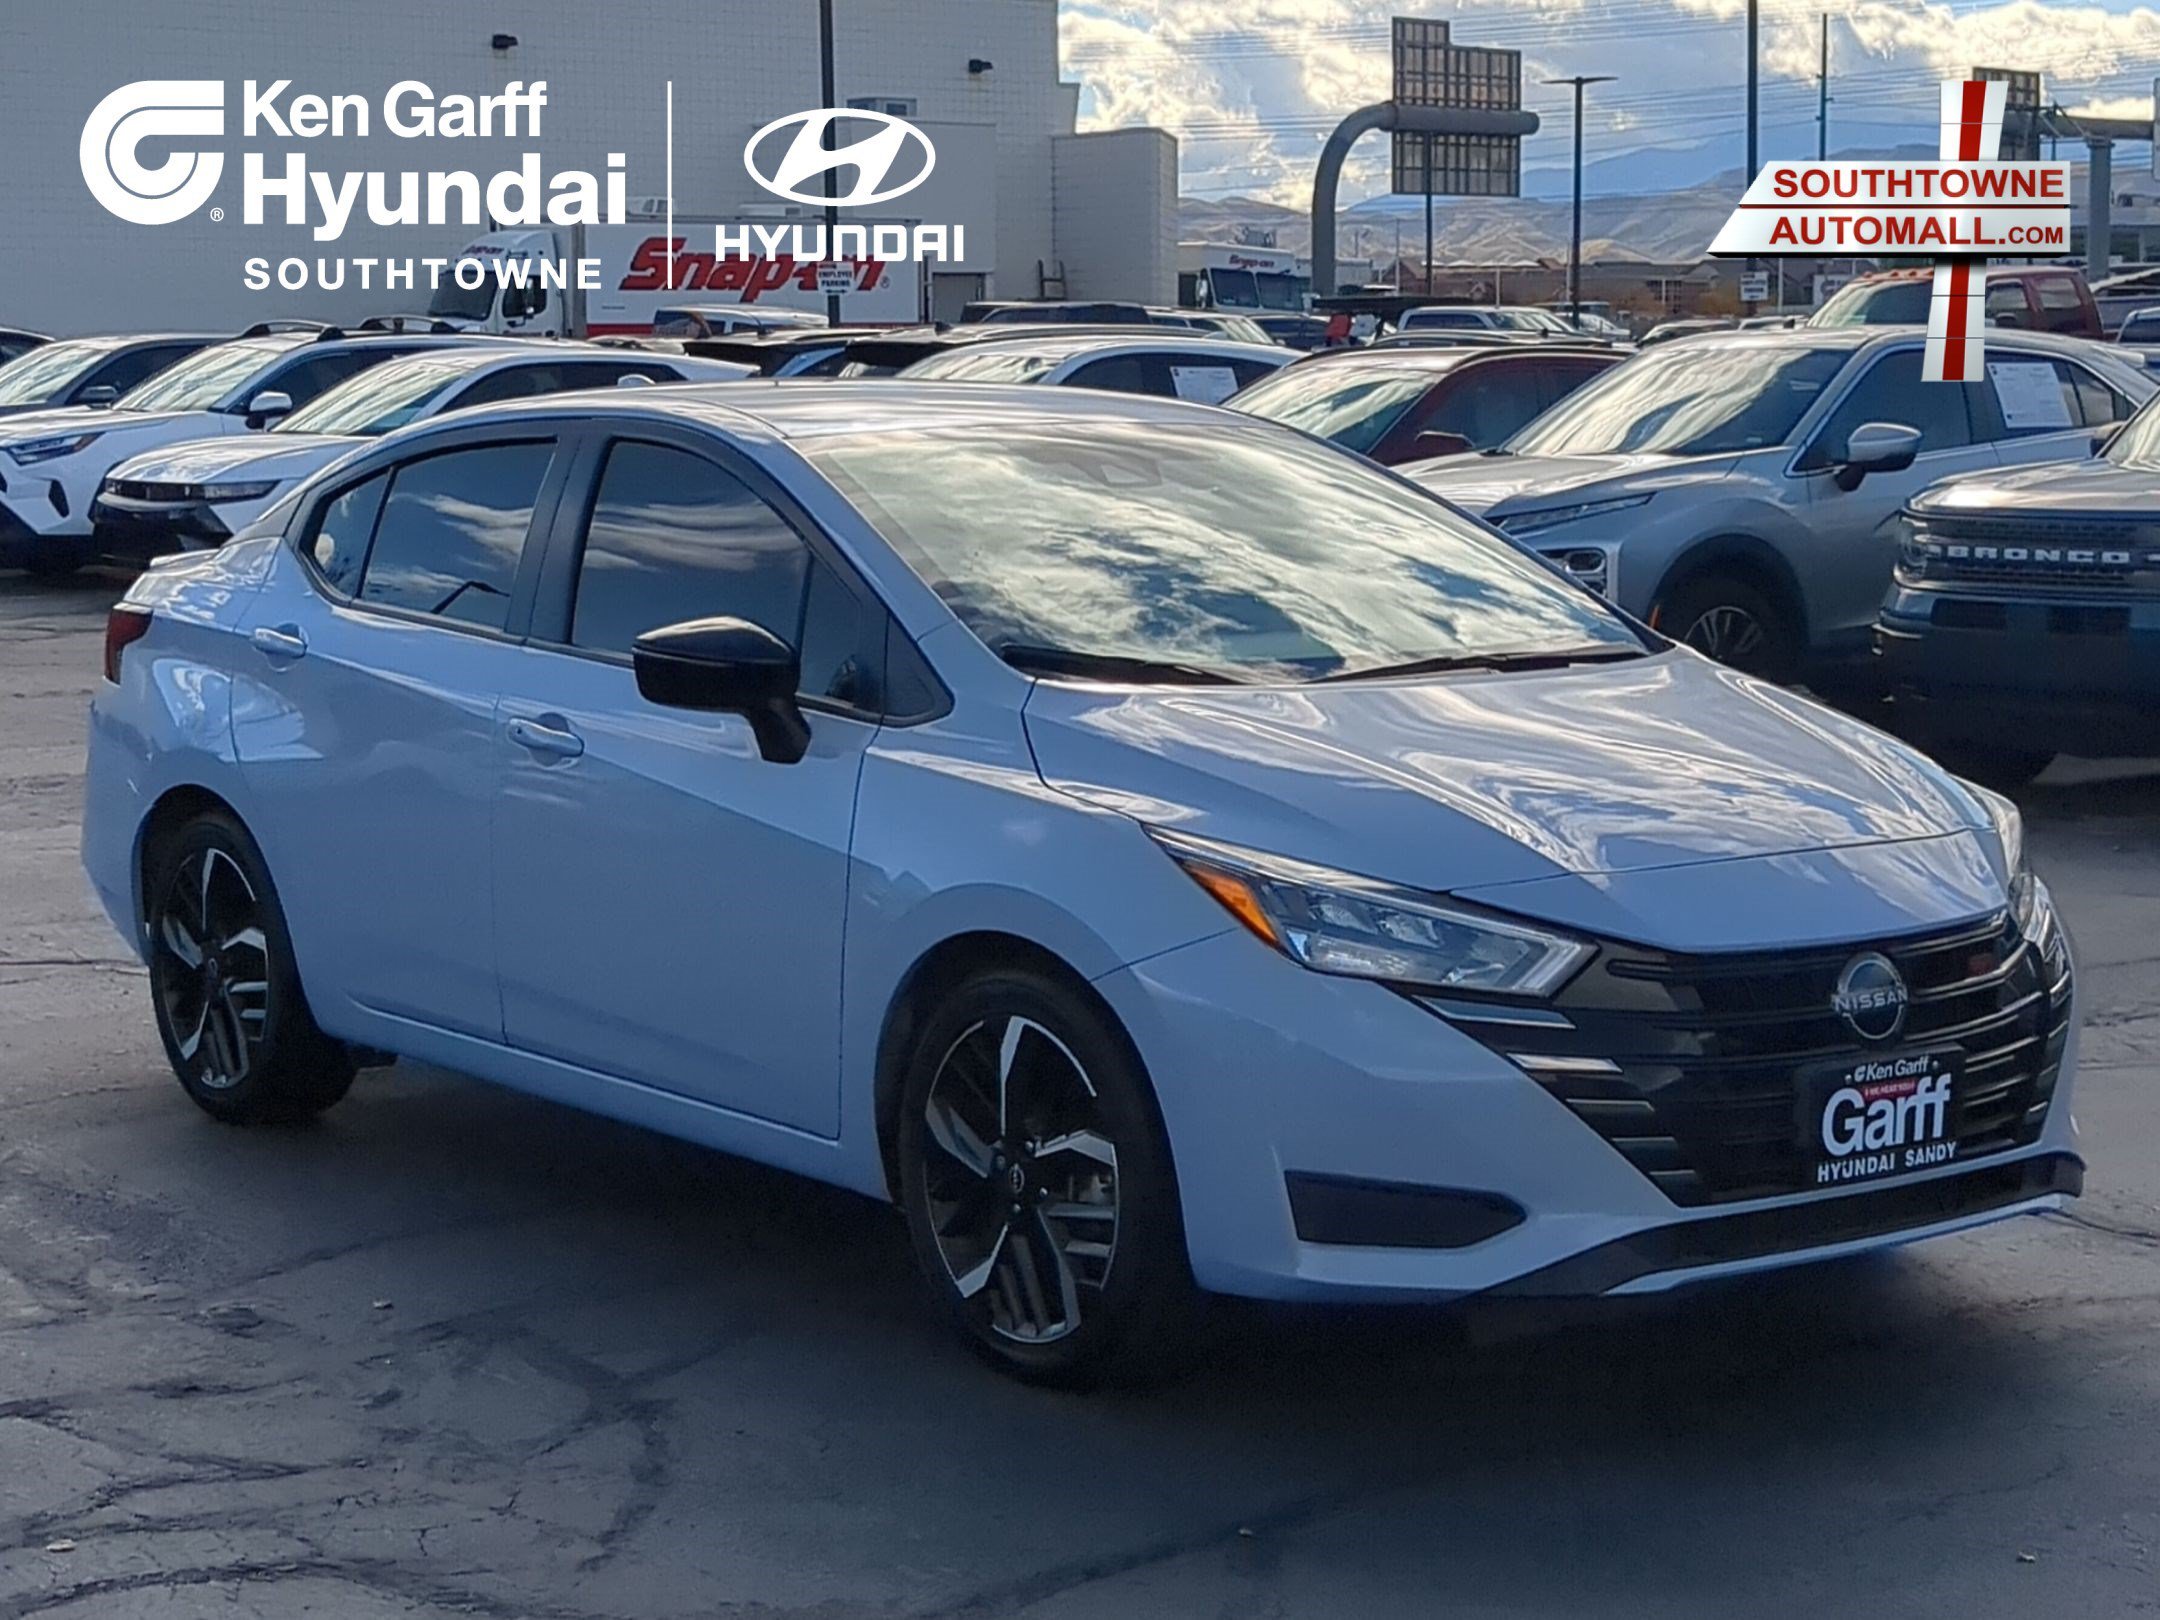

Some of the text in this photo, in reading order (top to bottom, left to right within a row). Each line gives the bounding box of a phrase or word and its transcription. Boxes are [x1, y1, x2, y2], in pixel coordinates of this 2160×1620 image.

[1947, 545, 2130, 563] BRONCO
[1834, 986, 1908, 1012] NISSAN
[1866, 1056, 1929, 1081] Ken Garff
[1822, 1073, 1952, 1157] Garff
[1817, 1141, 1957, 1182] HYUNDAI SANDY
